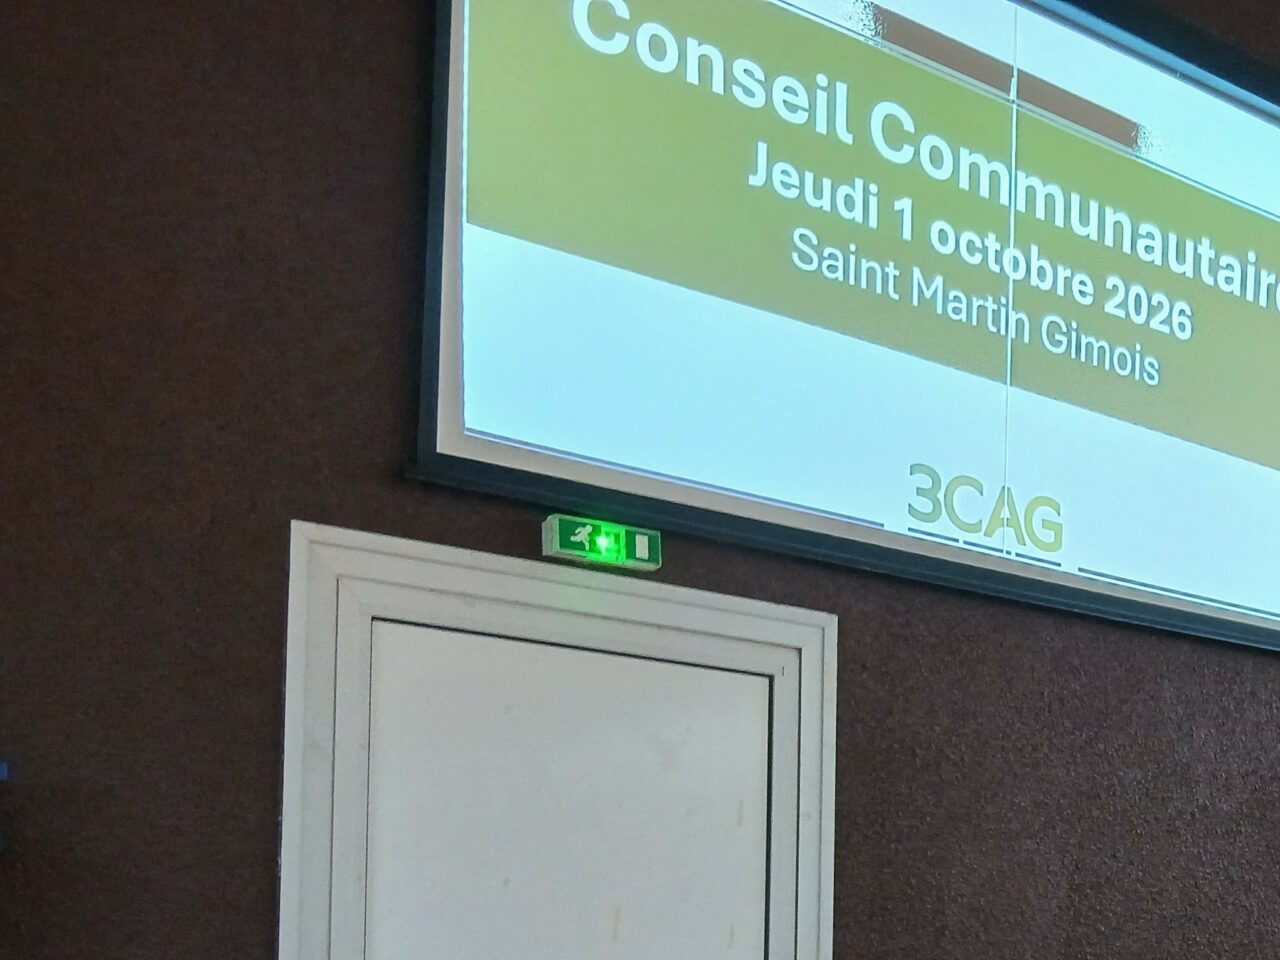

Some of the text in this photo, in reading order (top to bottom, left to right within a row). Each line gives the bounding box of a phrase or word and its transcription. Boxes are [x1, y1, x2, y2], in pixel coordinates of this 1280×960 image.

[572, 0, 854, 145] Conseil
[748, 140, 1193, 341] Jeudi 1 octobre 2026
[791, 227, 1161, 387] Saint Martin Gimois
[907, 463, 1063, 552] 3CAG
